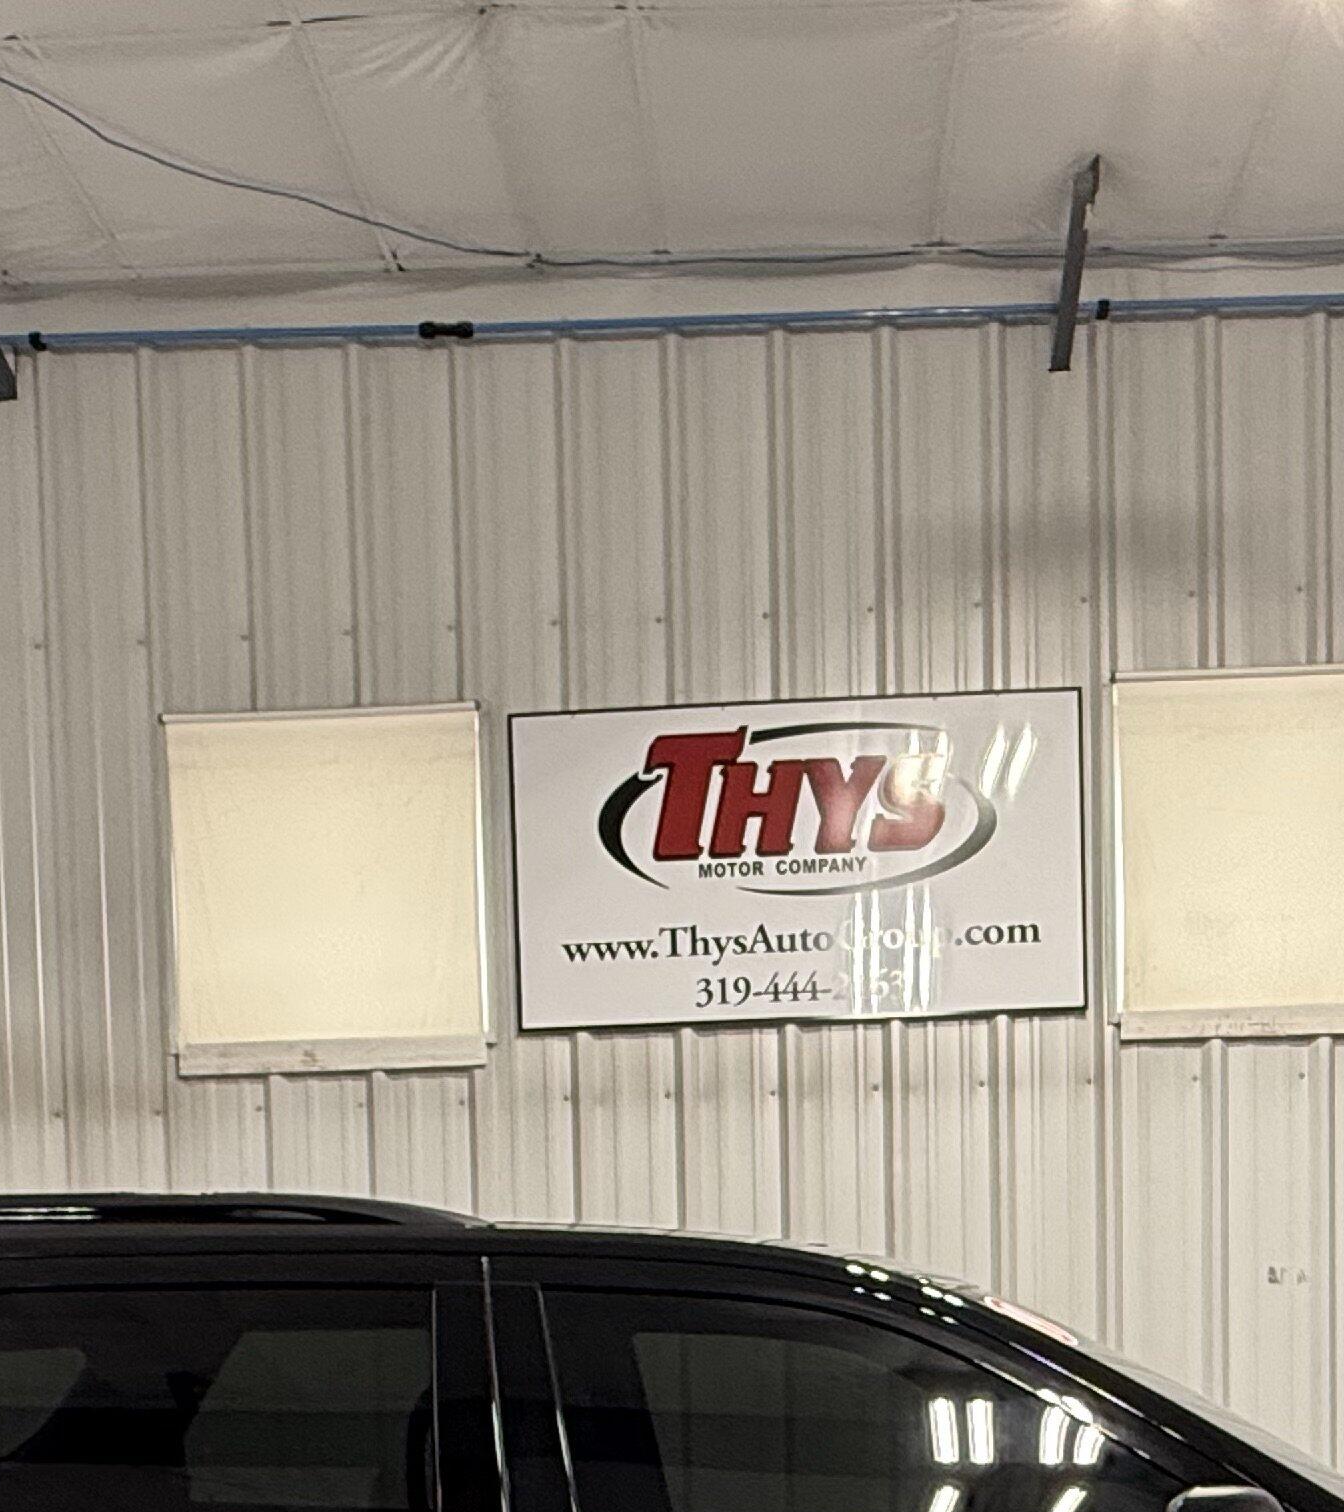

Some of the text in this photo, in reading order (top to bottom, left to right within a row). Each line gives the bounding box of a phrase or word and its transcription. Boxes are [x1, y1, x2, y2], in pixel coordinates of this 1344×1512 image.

[643, 725, 945, 862] THYS
[698, 855, 868, 878] MOTOR COMPANY
[562, 921, 1041, 966] www.ThysAutoGop.com
